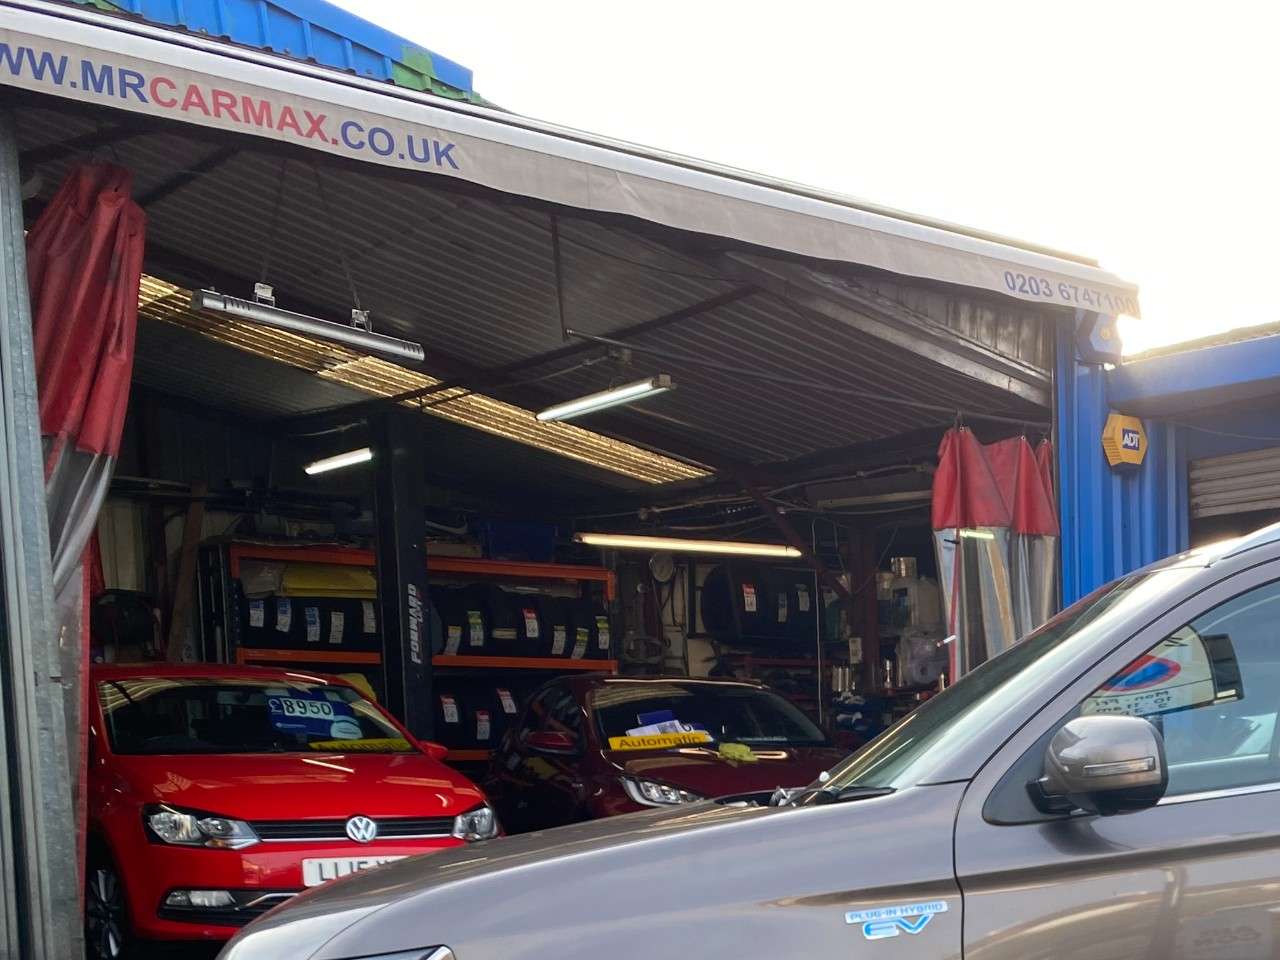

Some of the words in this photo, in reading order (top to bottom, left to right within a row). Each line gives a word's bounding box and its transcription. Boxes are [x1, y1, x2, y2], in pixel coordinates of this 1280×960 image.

[1004, 271, 1053, 298] 0203
[1122, 432, 1139, 448] ADT
[268, 697, 332, 716] £8950
[619, 735, 701, 747] Automatic
[849, 907, 897, 921] PLUG-IN
[900, 902, 944, 916] HYBRID
